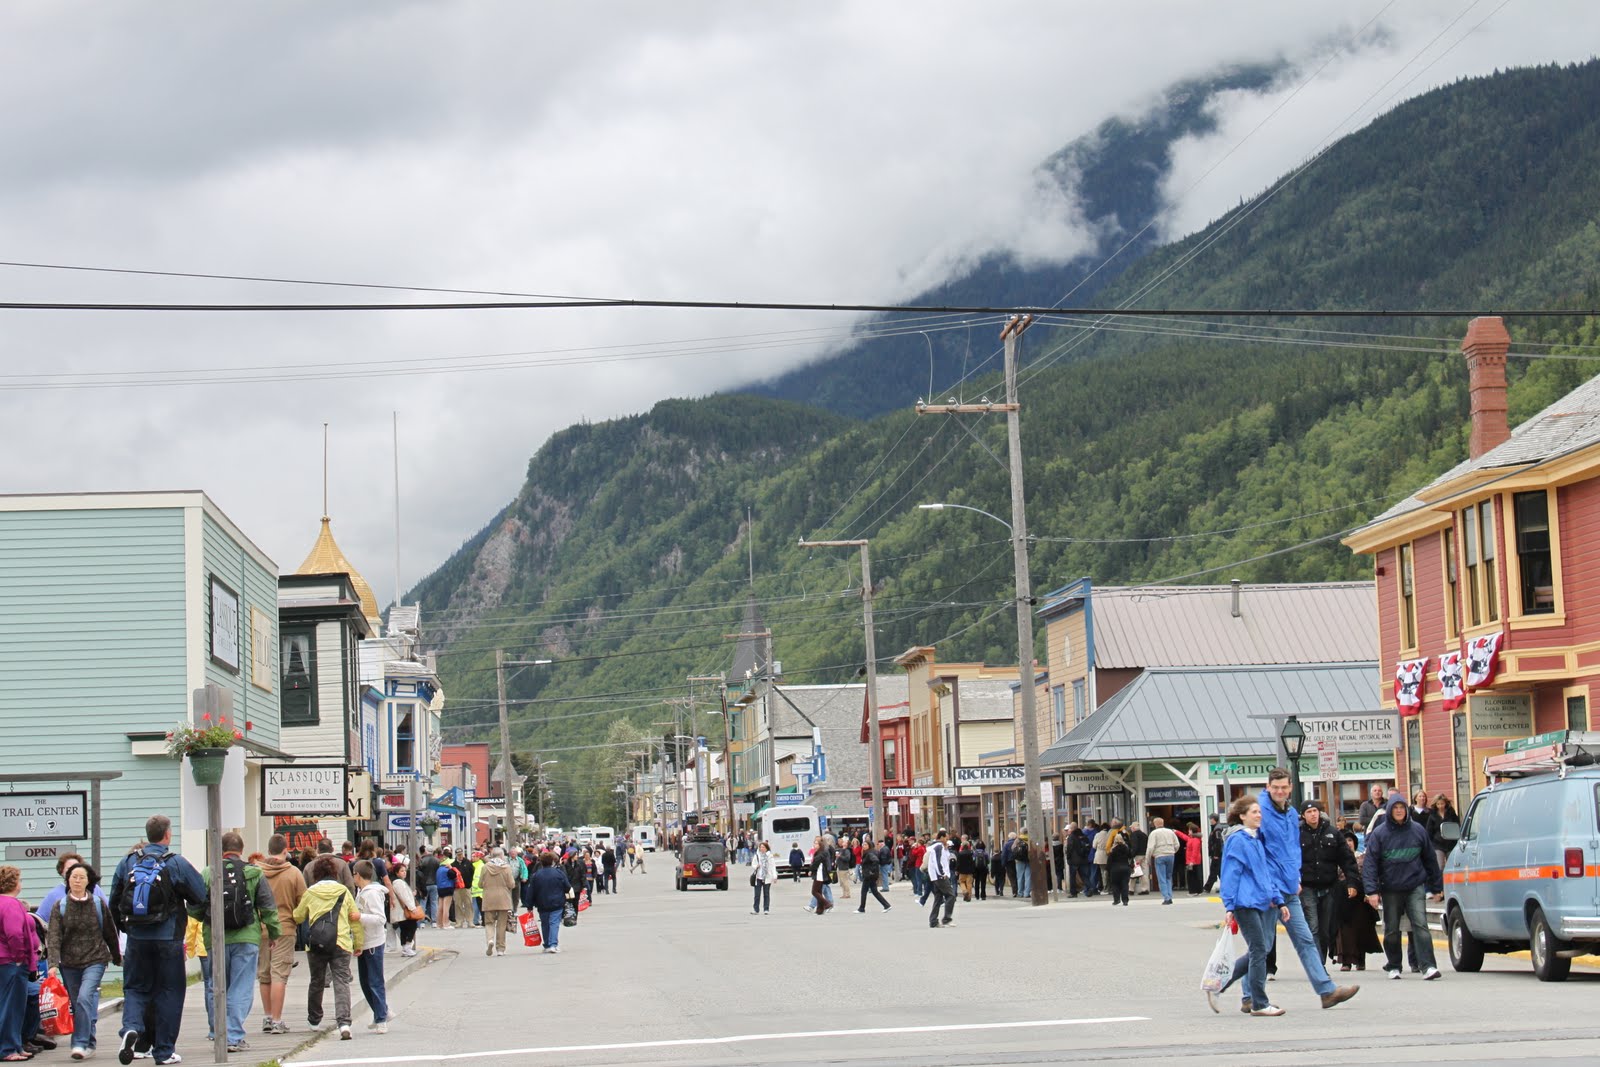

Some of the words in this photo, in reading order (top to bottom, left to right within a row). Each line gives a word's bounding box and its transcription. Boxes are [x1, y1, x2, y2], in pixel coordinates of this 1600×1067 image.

[1341, 718, 1391, 732] CENTER
[1503, 722, 1530, 730] CENTER
[269, 771, 341, 785] KLASSIQUE
[957, 767, 1025, 781] RICHTERS
[1069, 774, 1109, 782] Diamonds
[282, 788, 330, 796] JEWELERS
[2, 807, 34, 817] TRAIL
[37, 806, 79, 817] CENTER
[25, 847, 57, 858] OPEN
